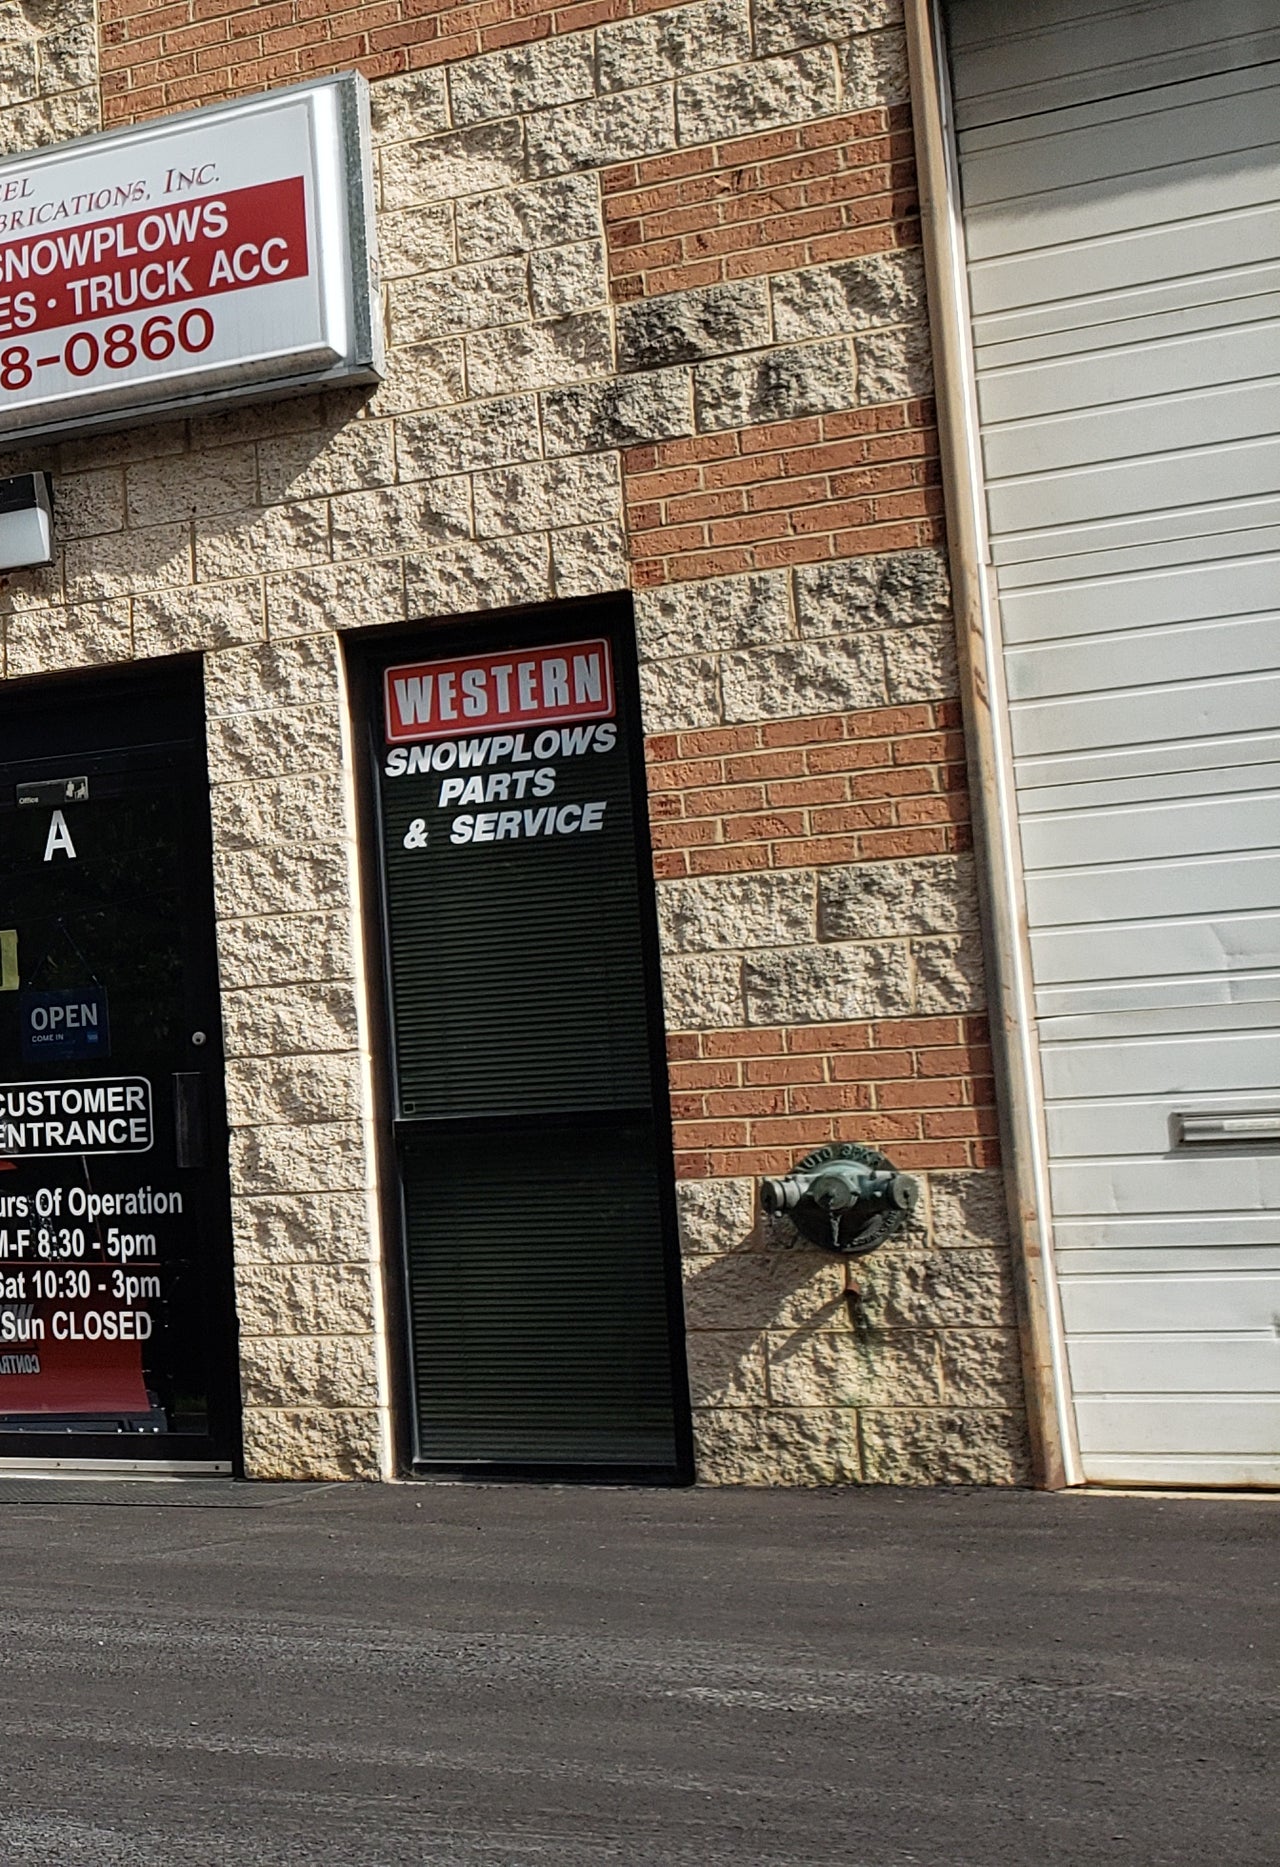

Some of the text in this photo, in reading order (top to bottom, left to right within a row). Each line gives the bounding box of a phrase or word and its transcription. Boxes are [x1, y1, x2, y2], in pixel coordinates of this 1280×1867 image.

[162, 163, 220, 195] INC.
[66, 257, 193, 315] TRUCK
[208, 237, 289, 288] ACC
[393, 653, 602, 726] WESTERN
[384, 723, 618, 777] SNOWPLOWS
[438, 767, 556, 808] PARTS
[43, 810, 77, 861] A
[403, 801, 607, 850] & SERVICE
[31, 1003, 98, 1030] OPEN
[32, 1034, 54, 1042] COME
[35, 1187, 63, 1217] Of
[68, 1186, 183, 1222] Operation
[37, 1228, 85, 1258] 8:30
[106, 1228, 157, 1263] 5pm
[32, 1269, 91, 1299] 10:30
[112, 1269, 161, 1304] 3pm
[1, 1310, 153, 1340] Sun CLOSED
